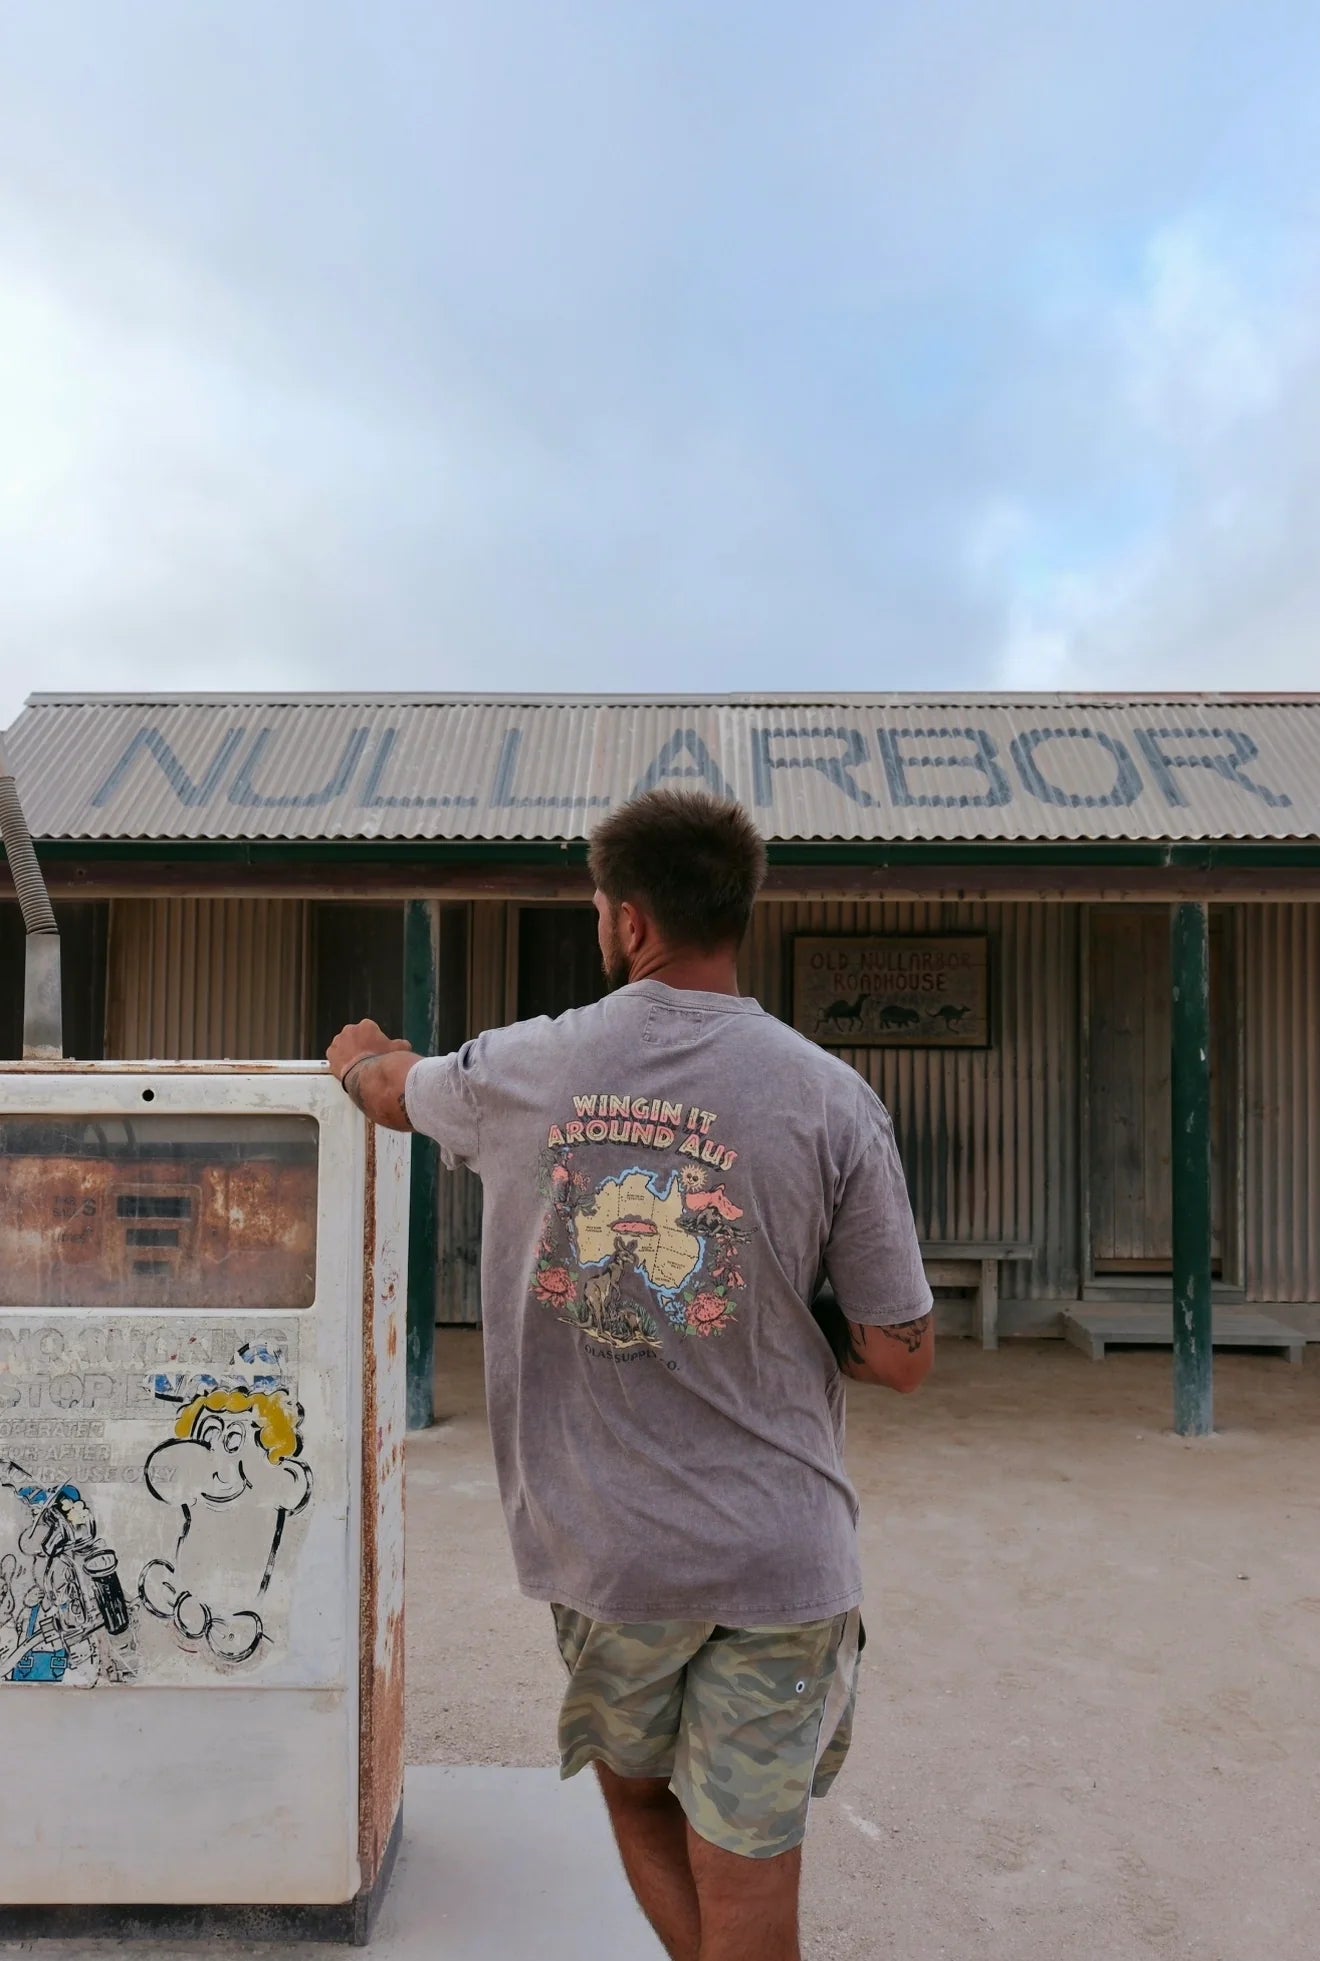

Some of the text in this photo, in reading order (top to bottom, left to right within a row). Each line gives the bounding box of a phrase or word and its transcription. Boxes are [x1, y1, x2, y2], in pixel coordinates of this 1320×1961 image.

[89, 725, 1293, 809] NULLARBOR
[810, 951, 972, 972] OLD NULLARBOR
[833, 972, 949, 993] ROADHOUSE
[572, 1094, 718, 1135] WINGIN IT
[548, 1119, 738, 1172] AROUND AUS
